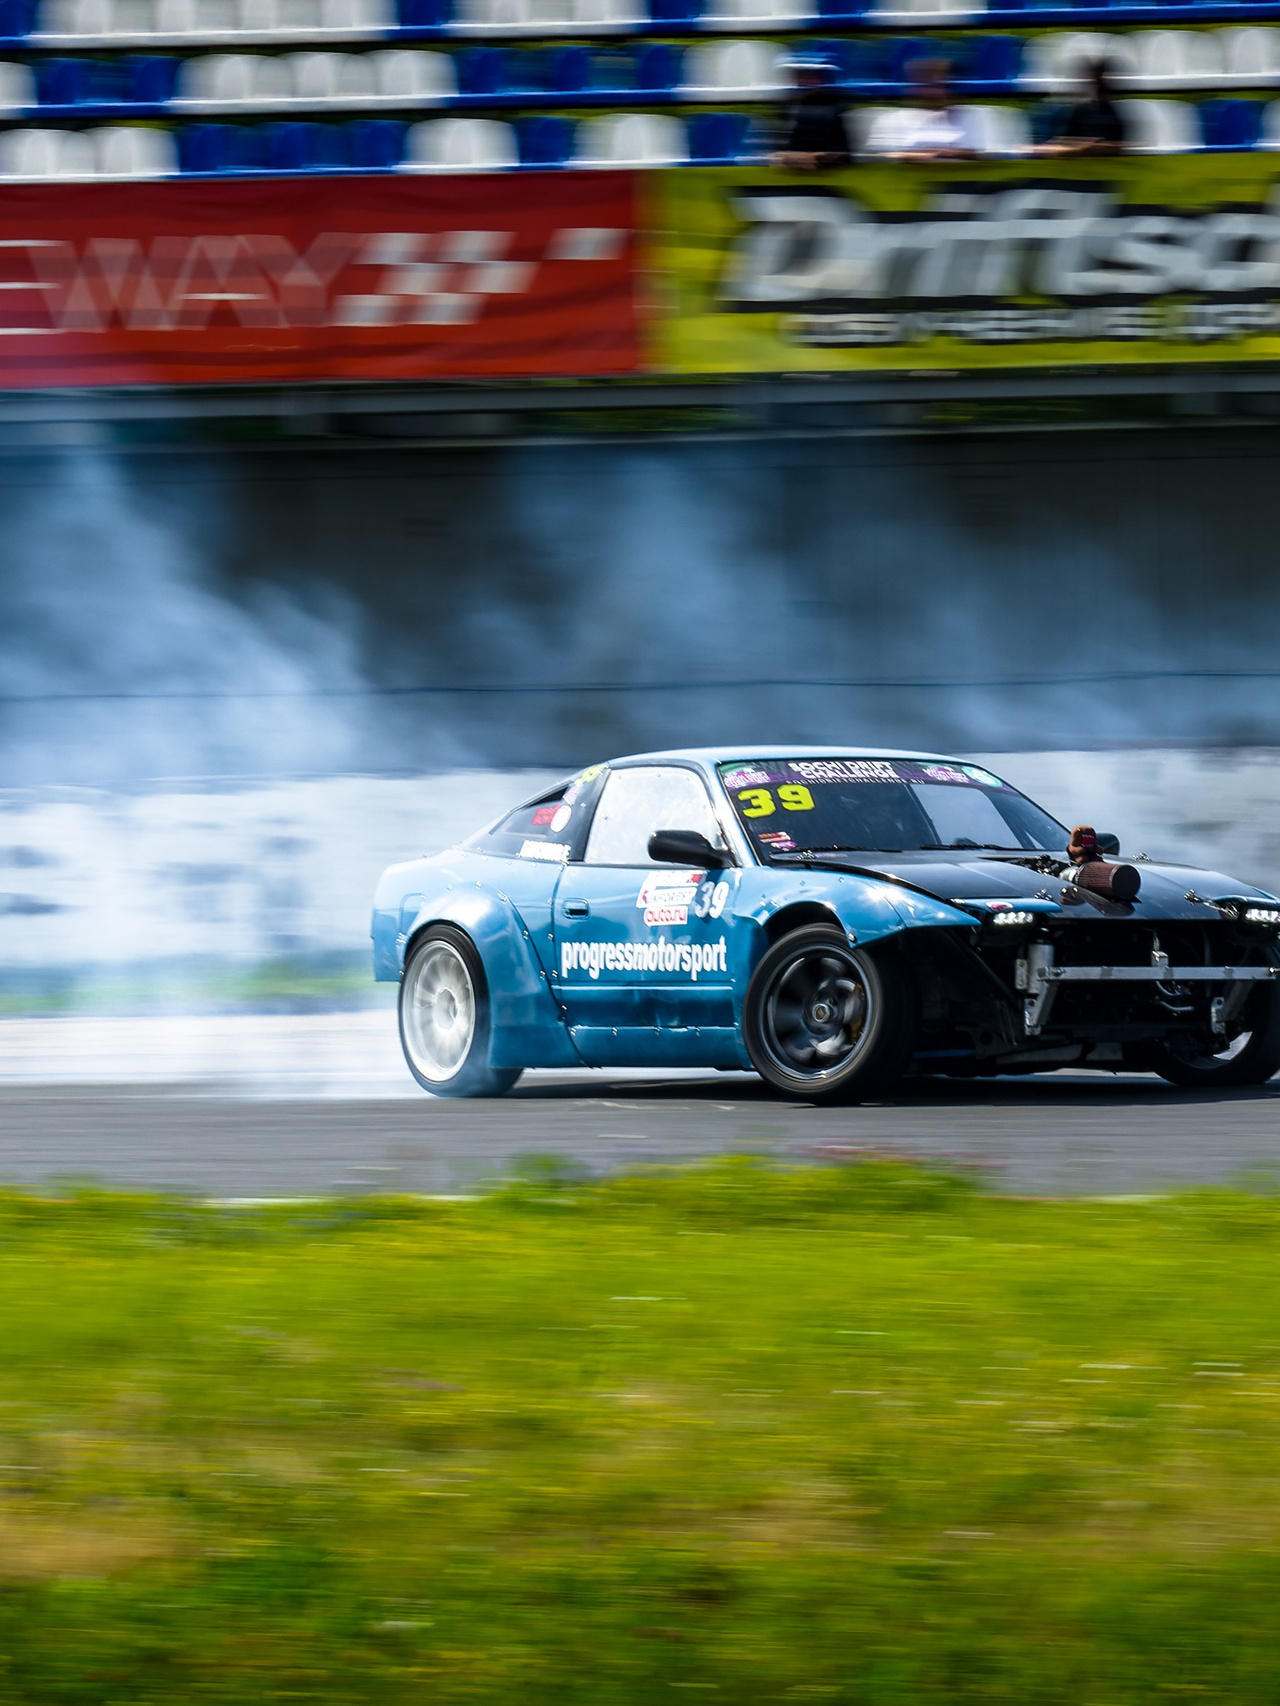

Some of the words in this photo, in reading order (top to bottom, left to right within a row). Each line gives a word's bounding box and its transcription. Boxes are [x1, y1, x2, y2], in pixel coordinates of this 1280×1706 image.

[800, 769, 900, 779] CHALLENGE
[737, 784, 816, 818] 39
[646, 908, 686, 923] auto.ru
[695, 880, 730, 920] 39
[561, 935, 727, 982] progressmotorsport
